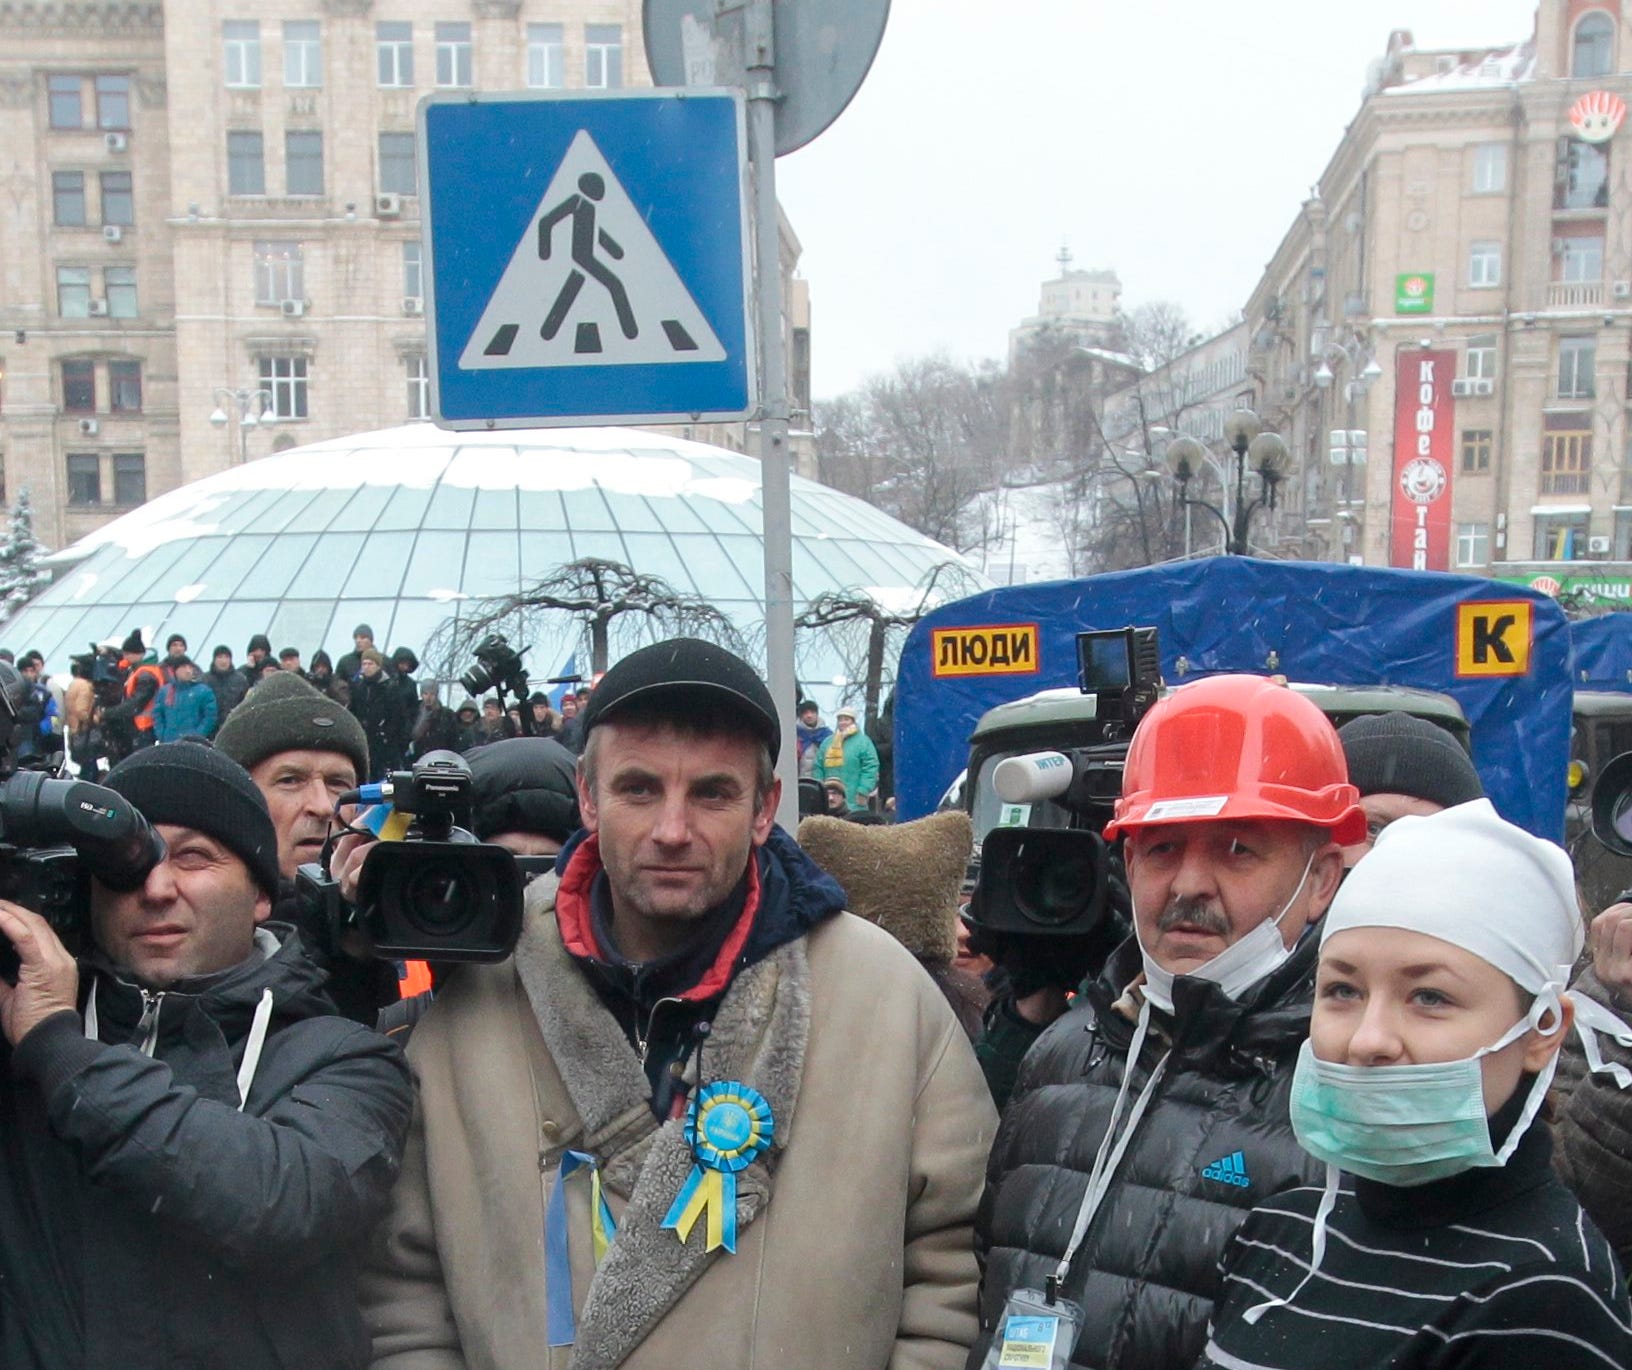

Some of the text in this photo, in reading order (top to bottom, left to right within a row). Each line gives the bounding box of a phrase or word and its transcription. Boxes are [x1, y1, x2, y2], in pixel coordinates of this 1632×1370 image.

[939, 632, 1031, 668] ЛЮДИ
[1472, 615, 1516, 664] К
[1201, 1167, 1250, 1188] adidas
